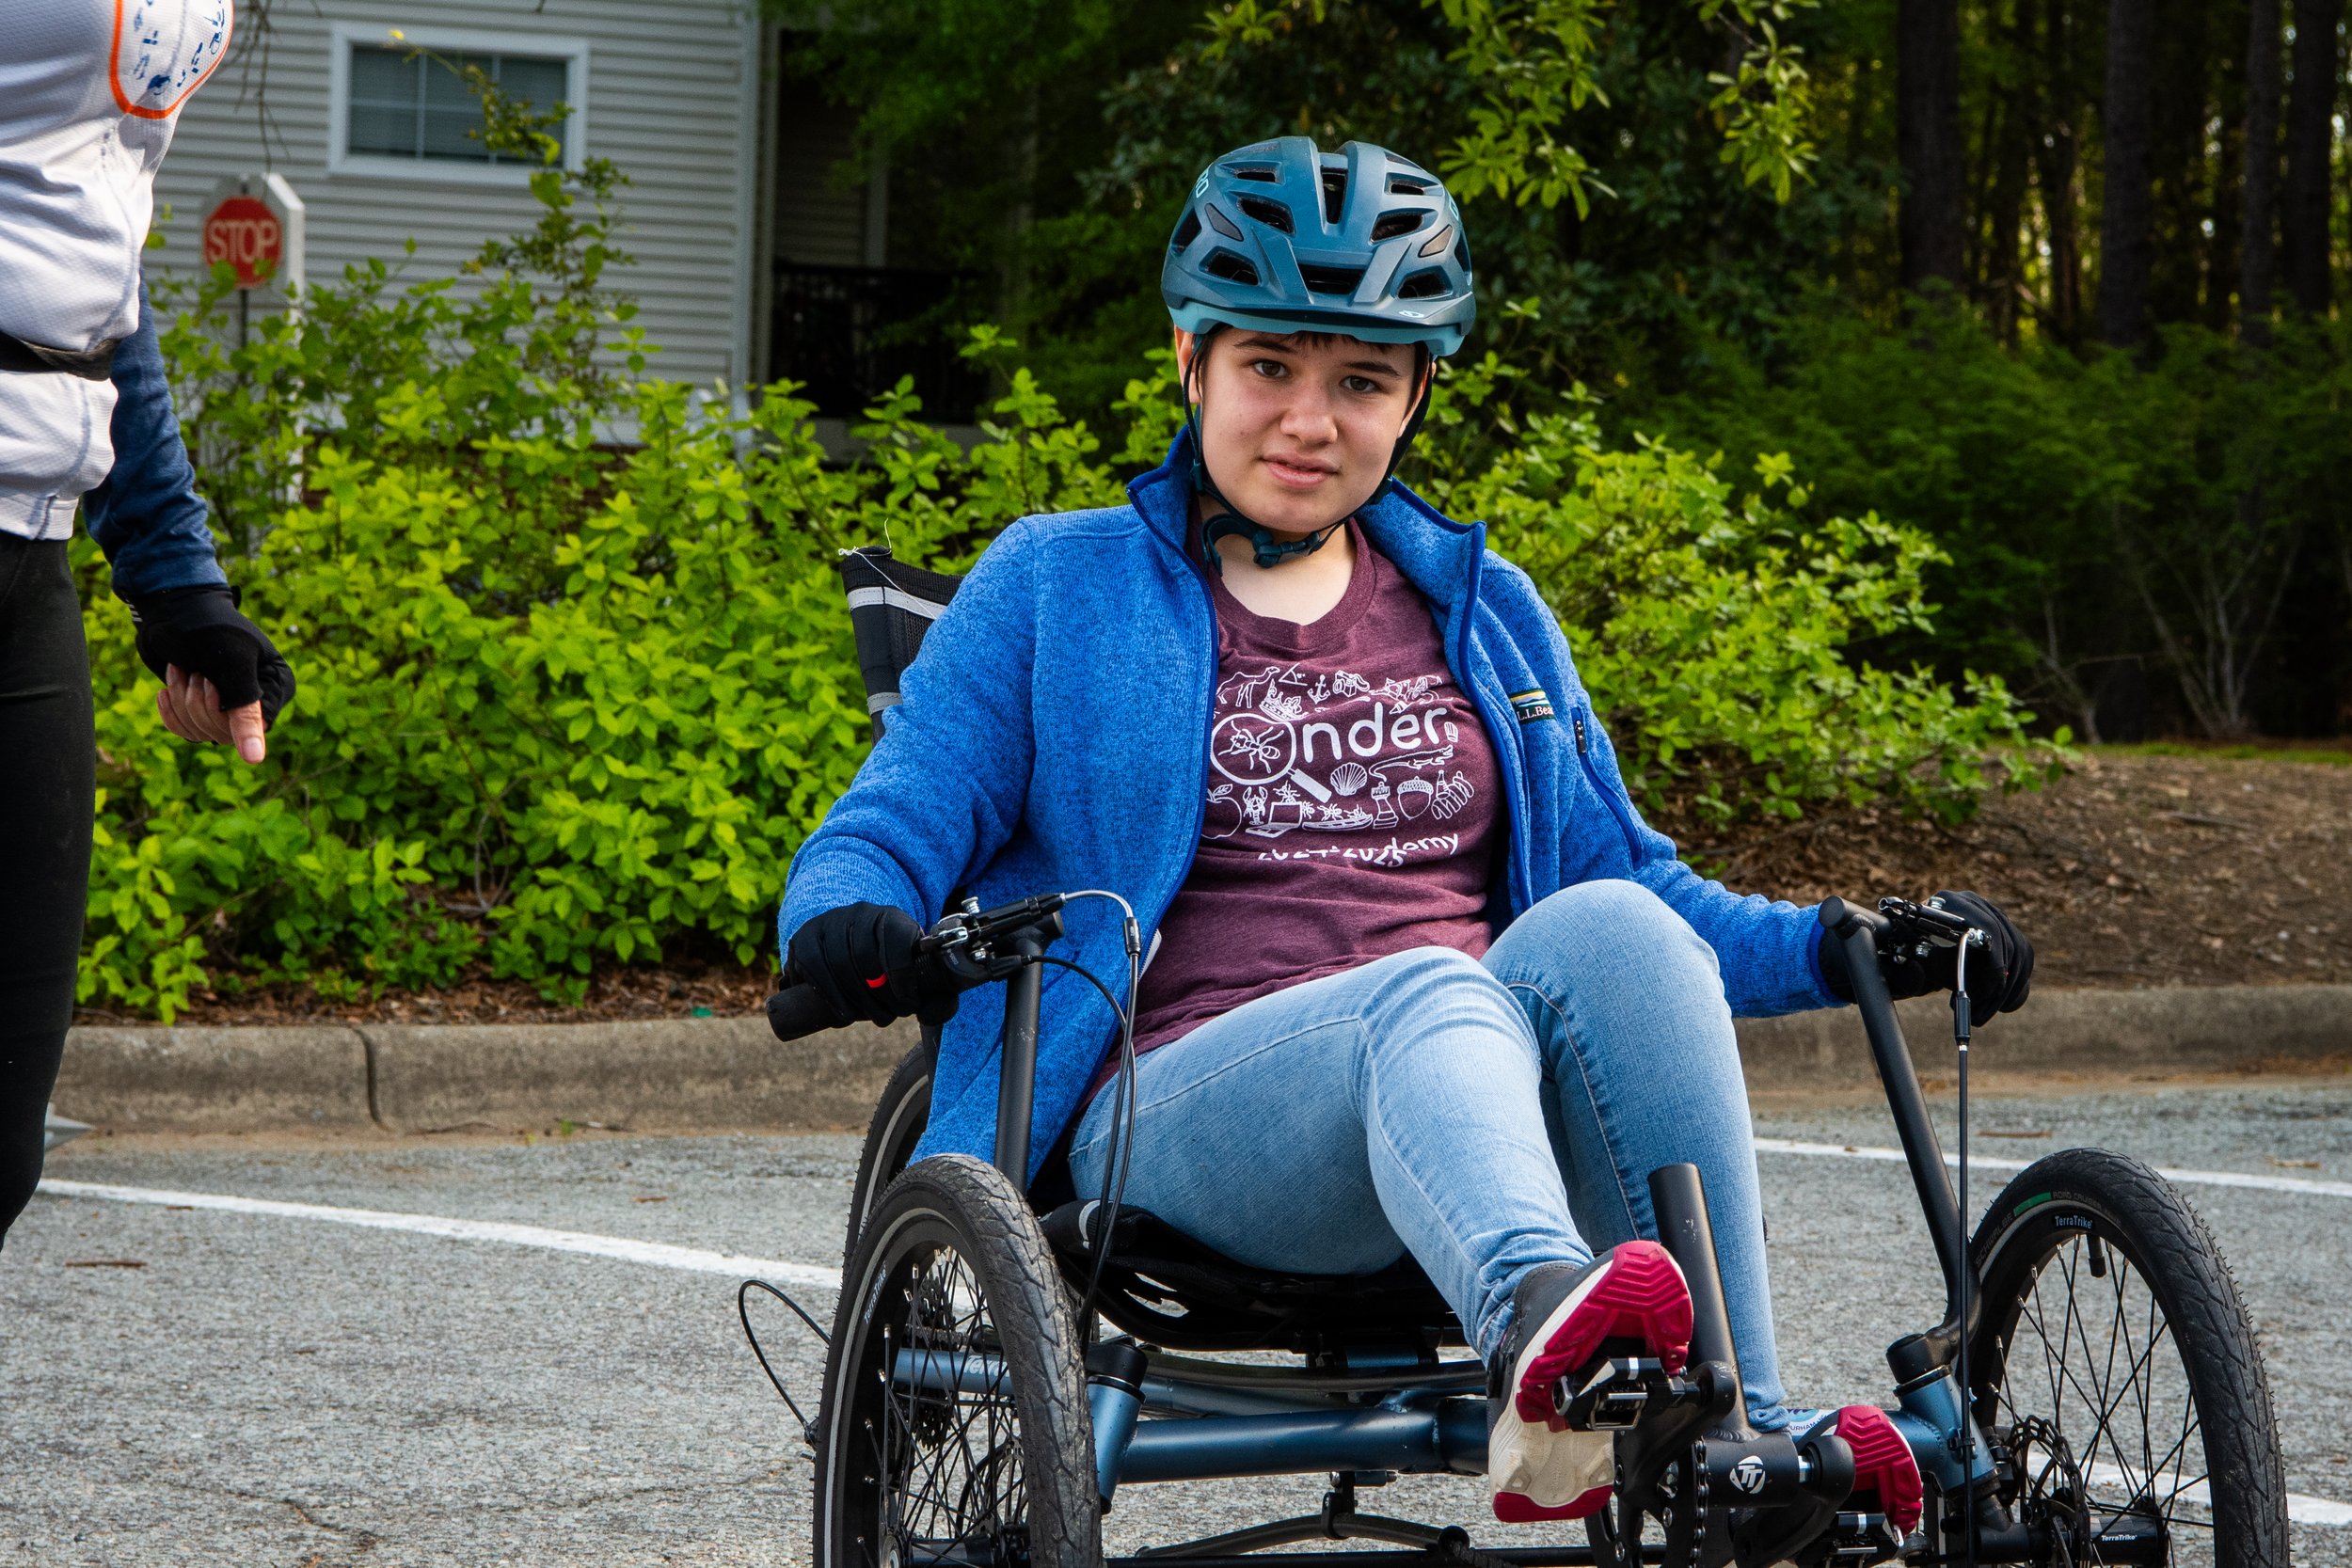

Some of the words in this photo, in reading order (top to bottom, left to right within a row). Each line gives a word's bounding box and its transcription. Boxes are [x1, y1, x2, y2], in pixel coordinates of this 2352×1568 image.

[207, 219, 278, 263] STOP
[1517, 705, 1554, 721] L.L.Bea
[2055, 1215, 2093, 1229] TerraTrike
[1975, 1212, 2014, 1267] SCHWALBE
[865, 1261, 886, 1324] TerraTrike
[1788, 1421, 1816, 1431] URHAM
